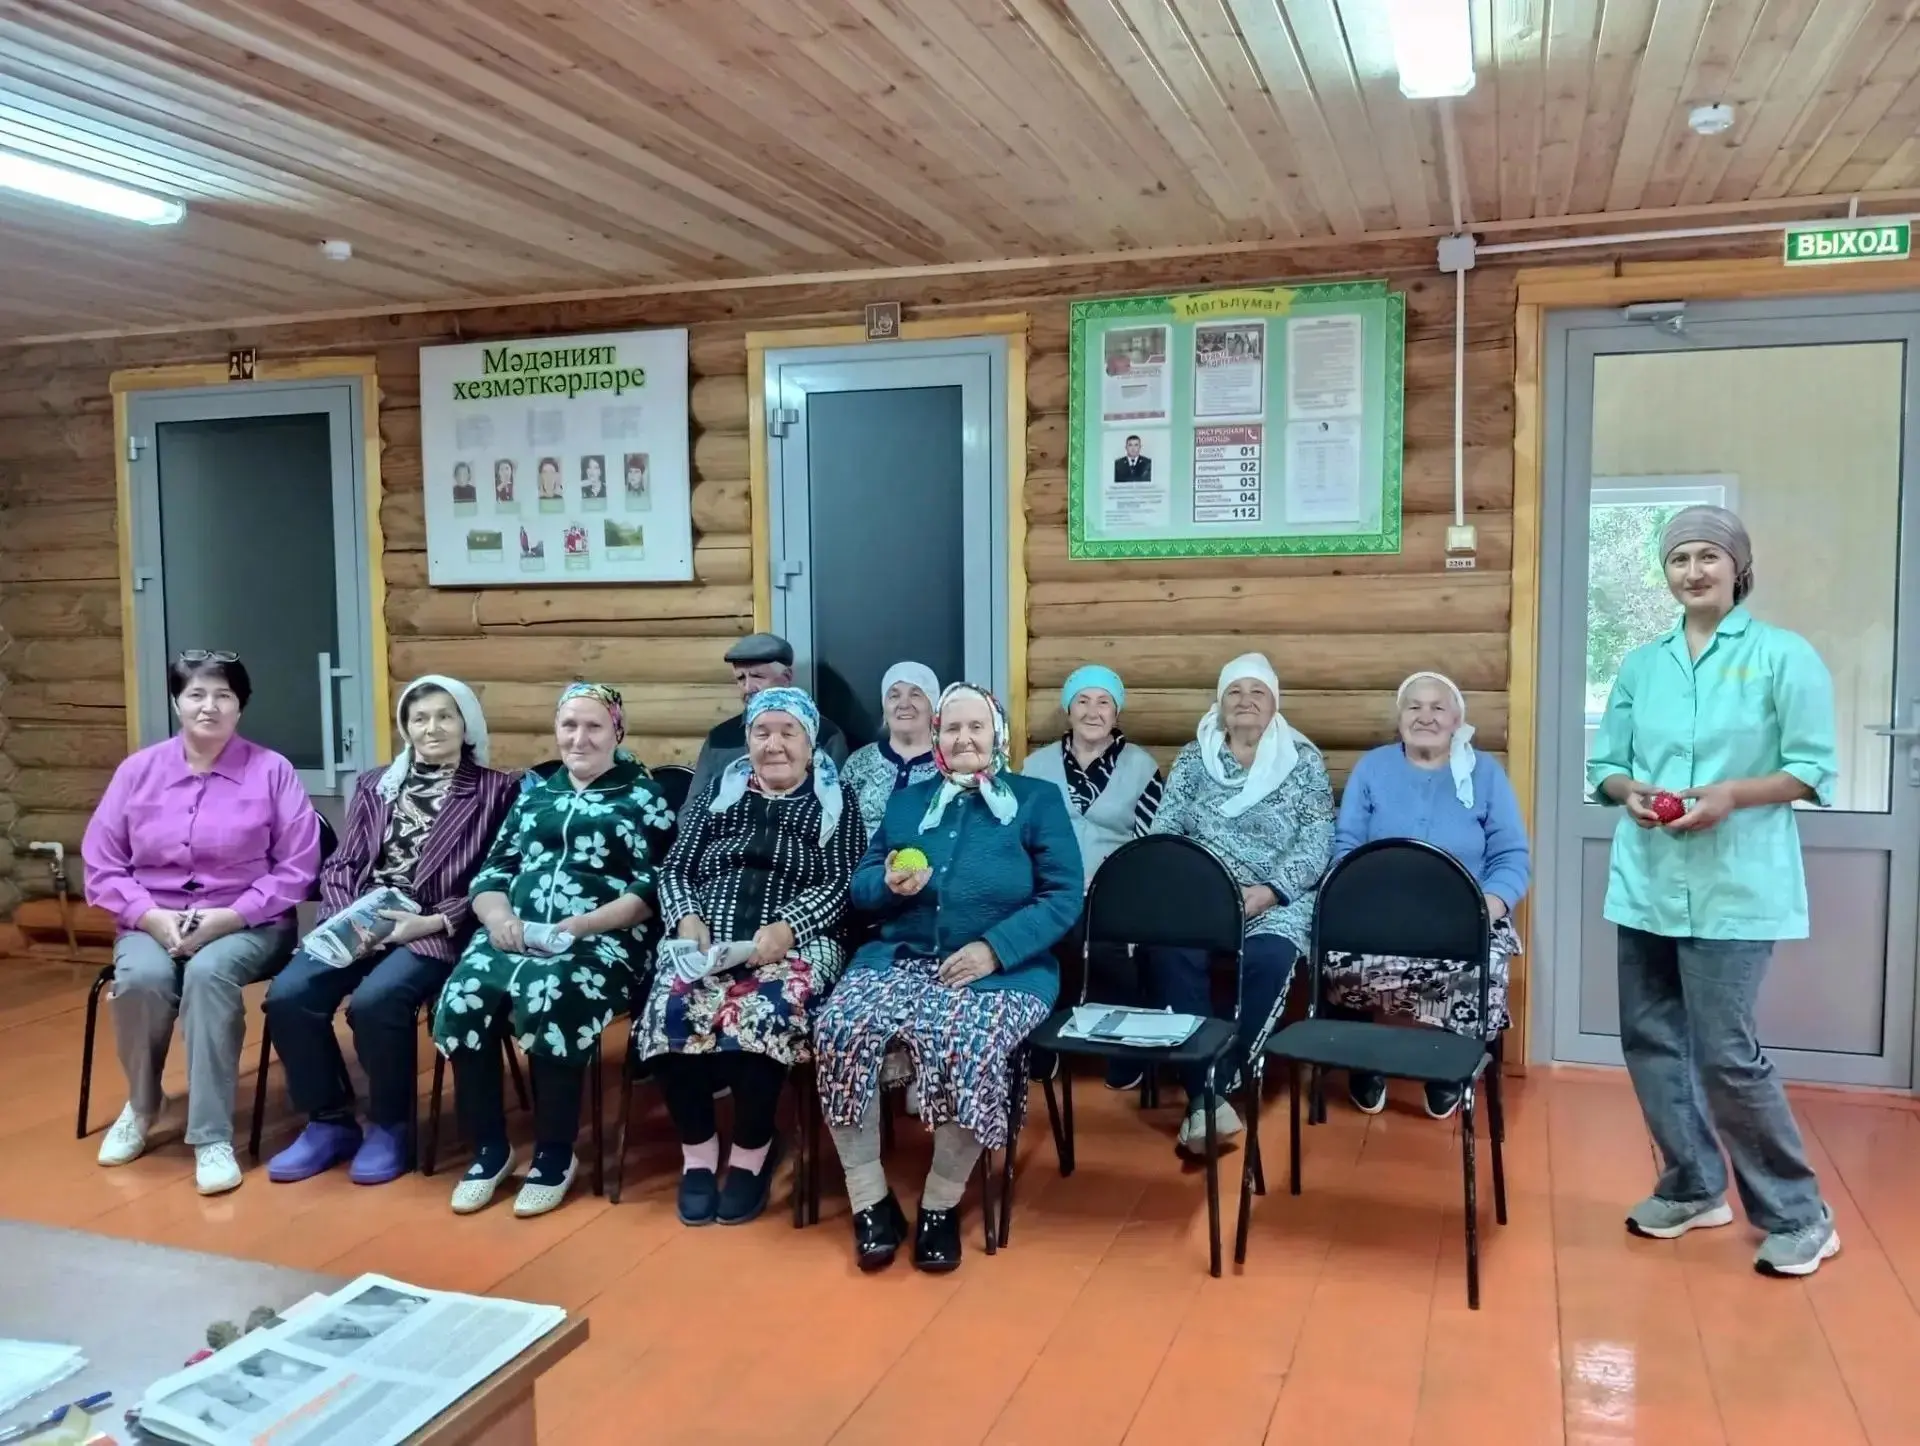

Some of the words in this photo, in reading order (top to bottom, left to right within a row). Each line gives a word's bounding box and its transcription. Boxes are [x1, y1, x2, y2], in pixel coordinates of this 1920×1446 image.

[1798, 229, 1899, 257] ВЫХОД
[483, 346, 616, 375] Мәдәният
[453, 368, 645, 400] хезмәткәрләре
[1240, 446, 1256, 457] 01
[1240, 461, 1256, 472] 02
[1240, 477, 1256, 488] 03
[1240, 492, 1256, 503] 04
[1232, 507, 1256, 518] 112
